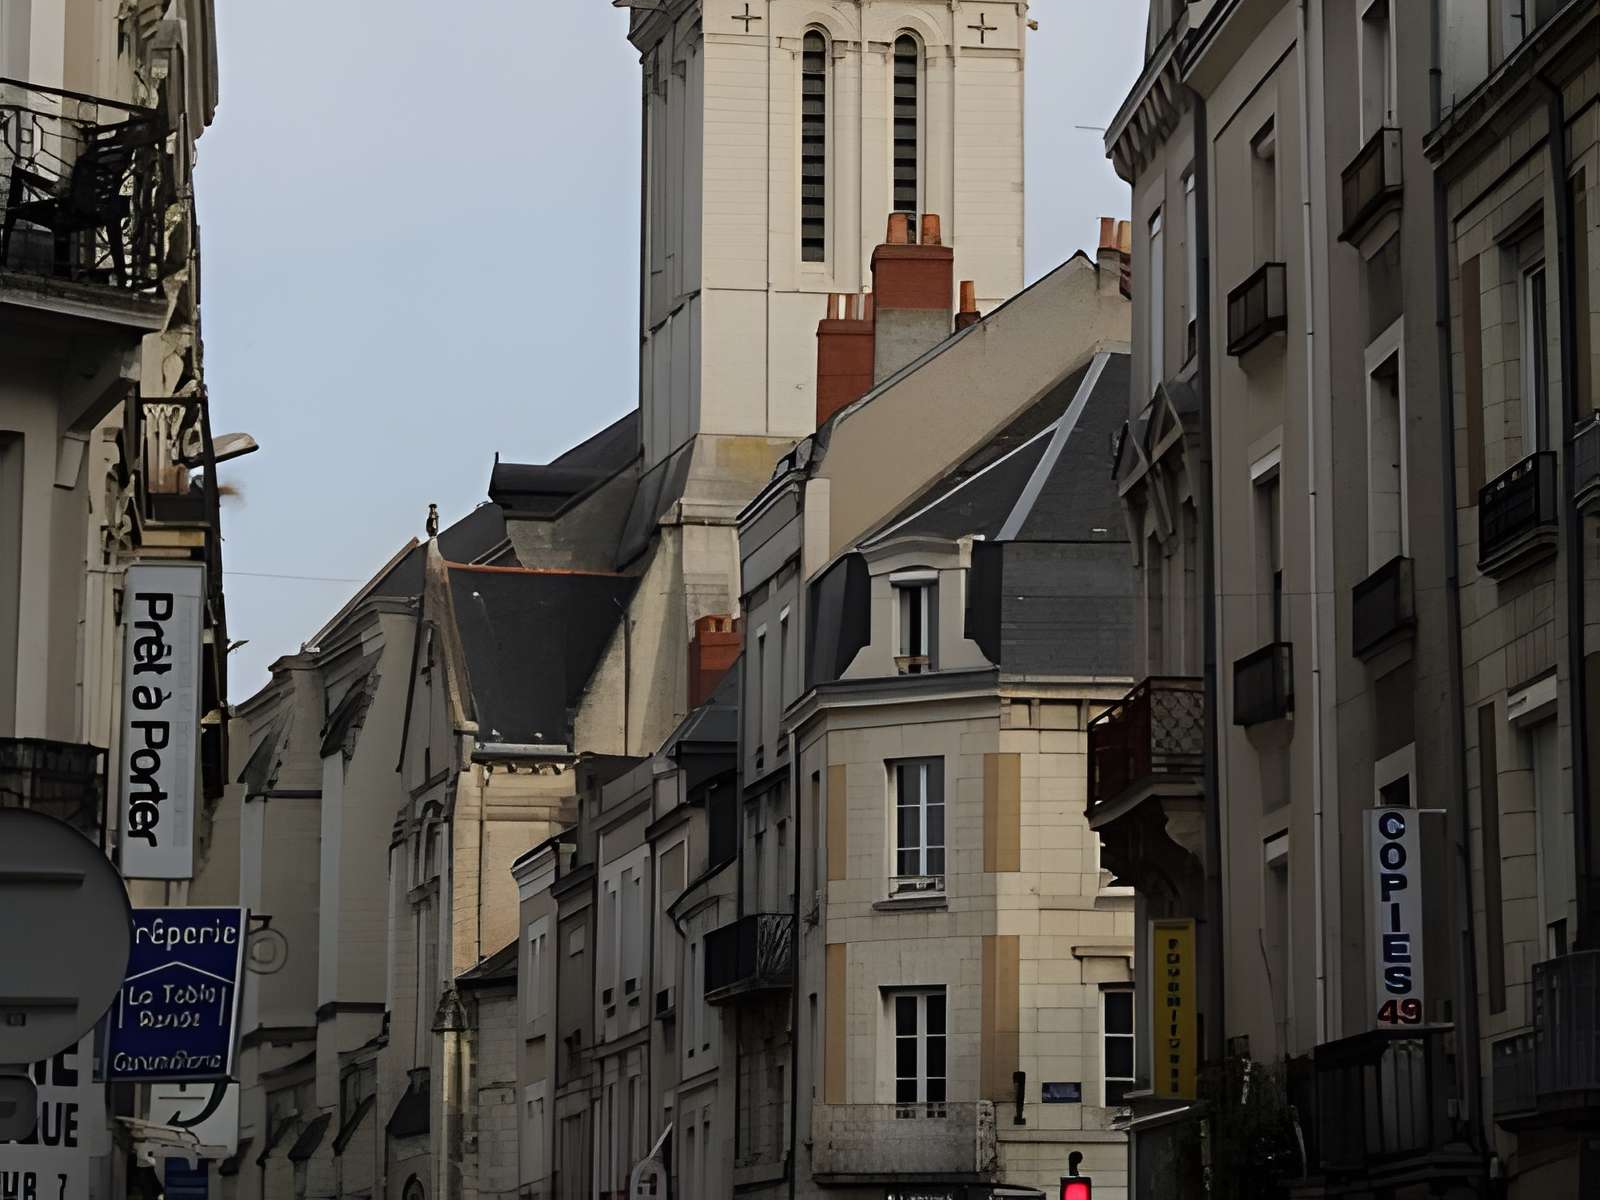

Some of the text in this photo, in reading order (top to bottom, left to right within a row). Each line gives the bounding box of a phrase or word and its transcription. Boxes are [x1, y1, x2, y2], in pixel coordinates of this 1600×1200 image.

[128, 592, 173, 848] Prêt à Porter
[132, 918, 237, 951] rêperie
[1378, 811, 1412, 995] COPIES
[1377, 998, 1422, 1025] 49
